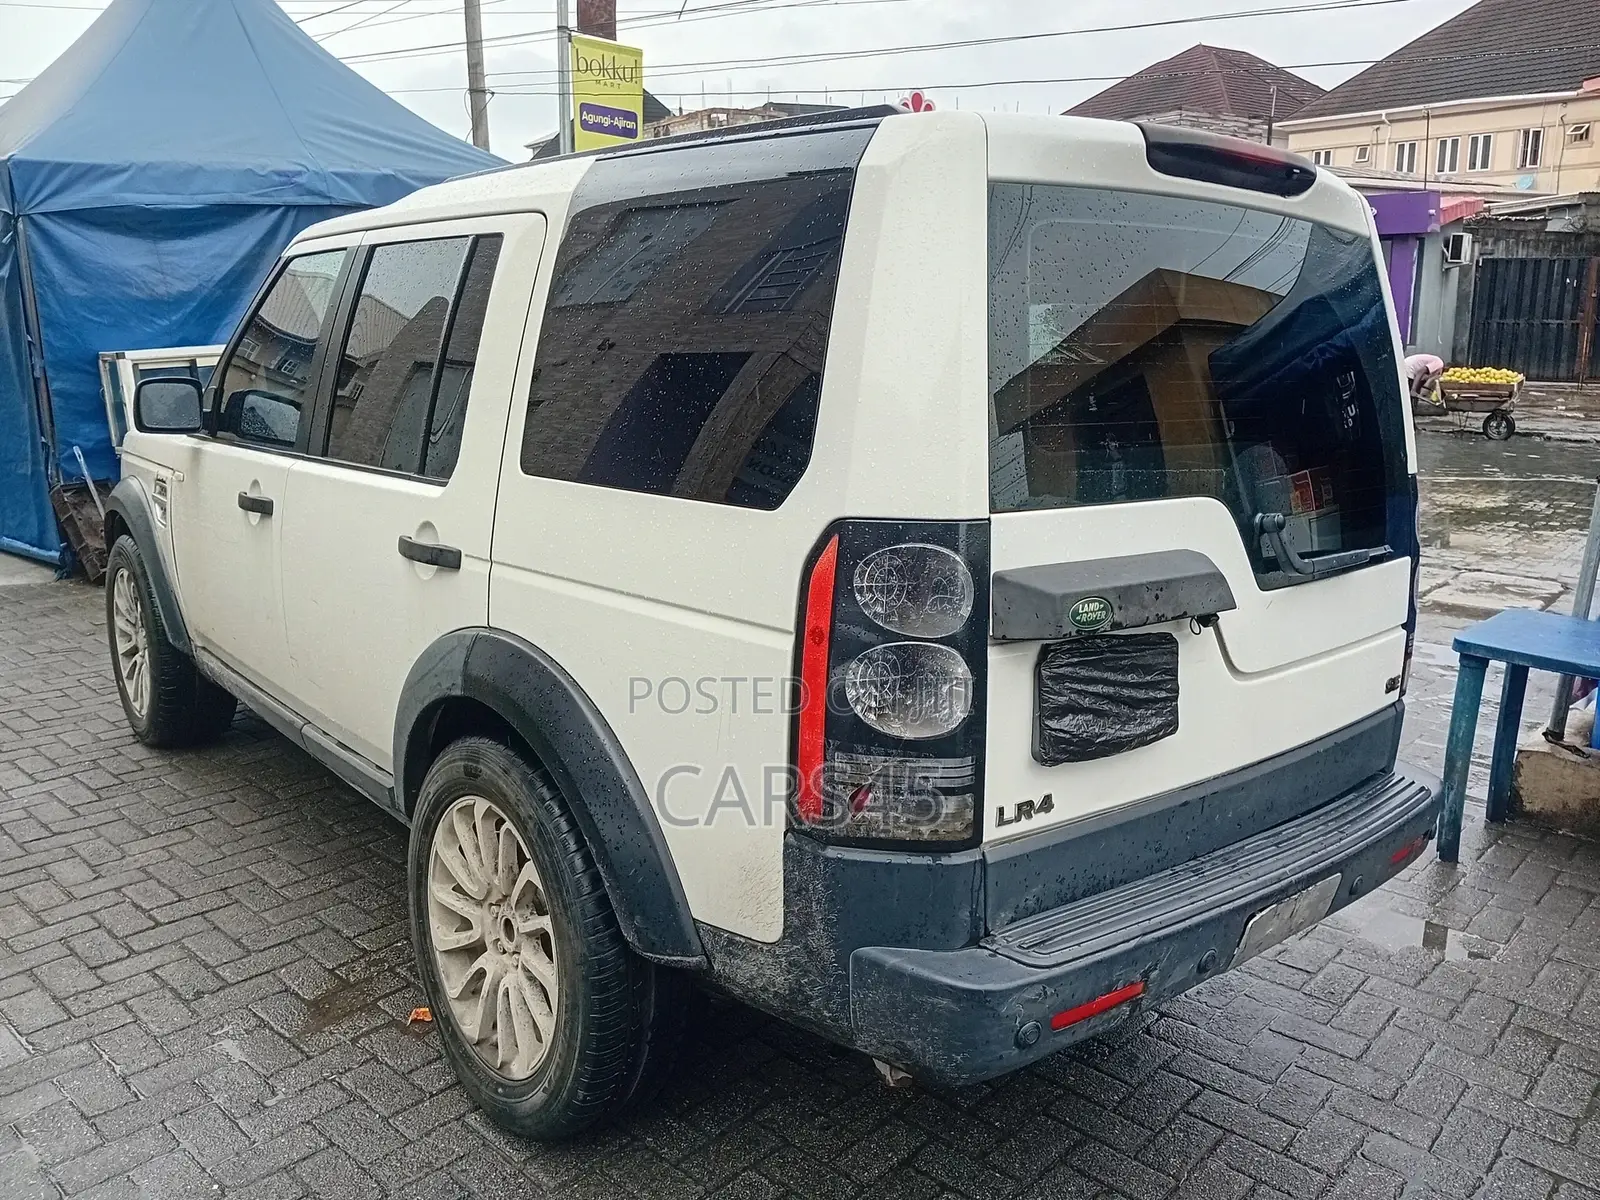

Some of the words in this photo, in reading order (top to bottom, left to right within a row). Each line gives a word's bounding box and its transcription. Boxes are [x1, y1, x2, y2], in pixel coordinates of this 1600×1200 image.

[576, 48, 638, 84] bokku!
[595, 80, 621, 89] MART
[581, 111, 636, 129] Agungi-Ajiran
[1079, 602, 1100, 613] LAND
[1081, 611, 1106, 622] ROVER
[995, 793, 1055, 828] LR4
